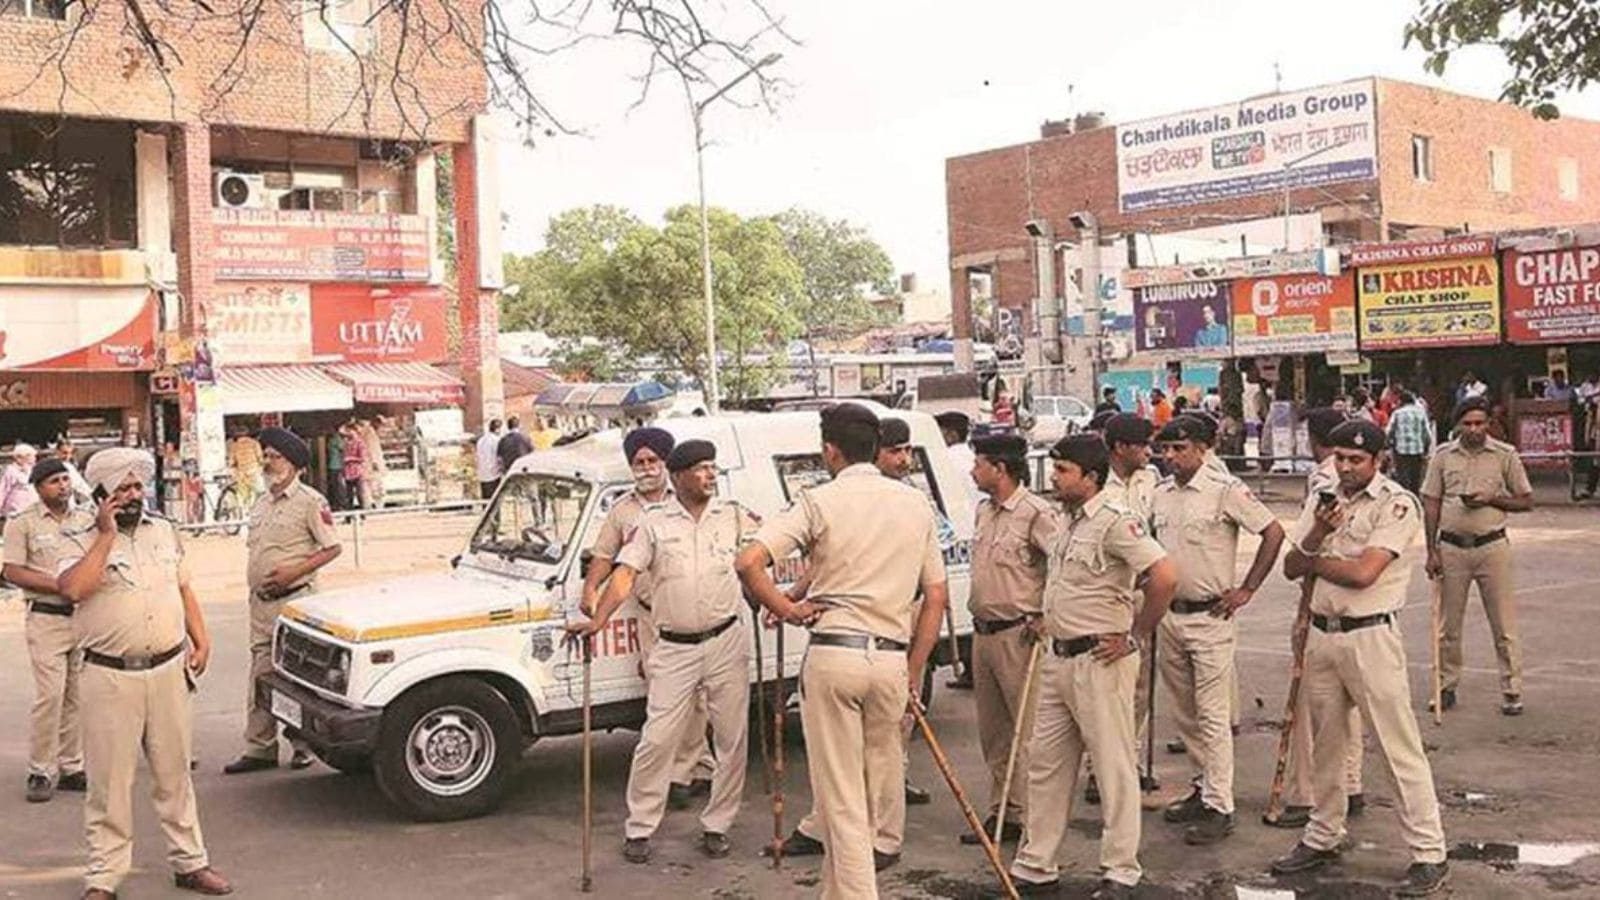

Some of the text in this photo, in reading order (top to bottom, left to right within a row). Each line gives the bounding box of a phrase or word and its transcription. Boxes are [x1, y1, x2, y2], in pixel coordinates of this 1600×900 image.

[1121, 114, 1231, 148] Charhdikala
[1237, 101, 1297, 128] Media
[1303, 91, 1368, 116] Group
[1352, 241, 1487, 263] KRISHNA CHAT SHOP
[1284, 278, 1334, 298] orient
[1383, 264, 1493, 293] KRISHNA
[1385, 291, 1470, 306] CHAT SHOP
[1533, 284, 1577, 307] FAST
[339, 319, 424, 346] UTTAM
